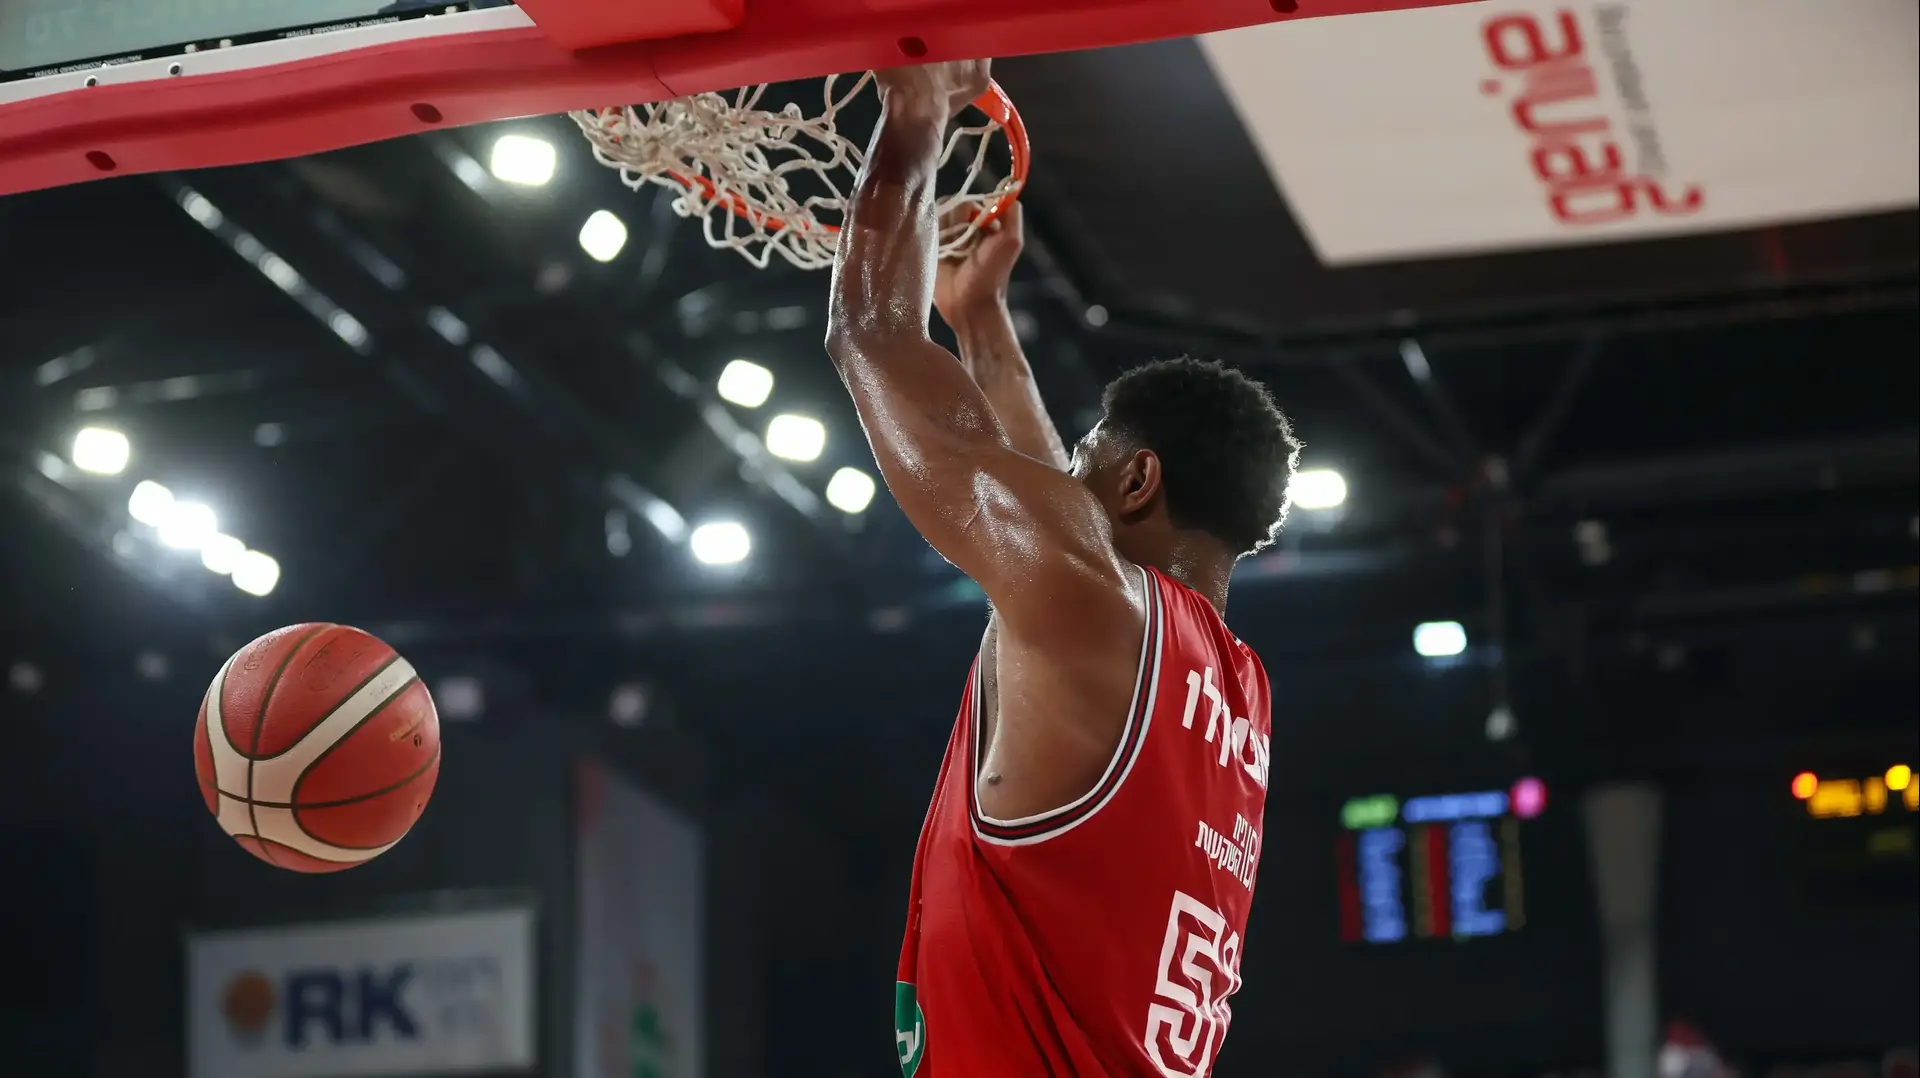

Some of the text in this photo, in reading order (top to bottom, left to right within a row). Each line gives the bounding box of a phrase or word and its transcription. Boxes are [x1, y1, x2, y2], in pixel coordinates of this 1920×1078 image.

[285, 28, 311, 38] SYSTEM
[312, 21, 358, 34] SCOREBOARD
[34, 68, 59, 77] SYSTEM
[283, 963, 421, 1052] RK
